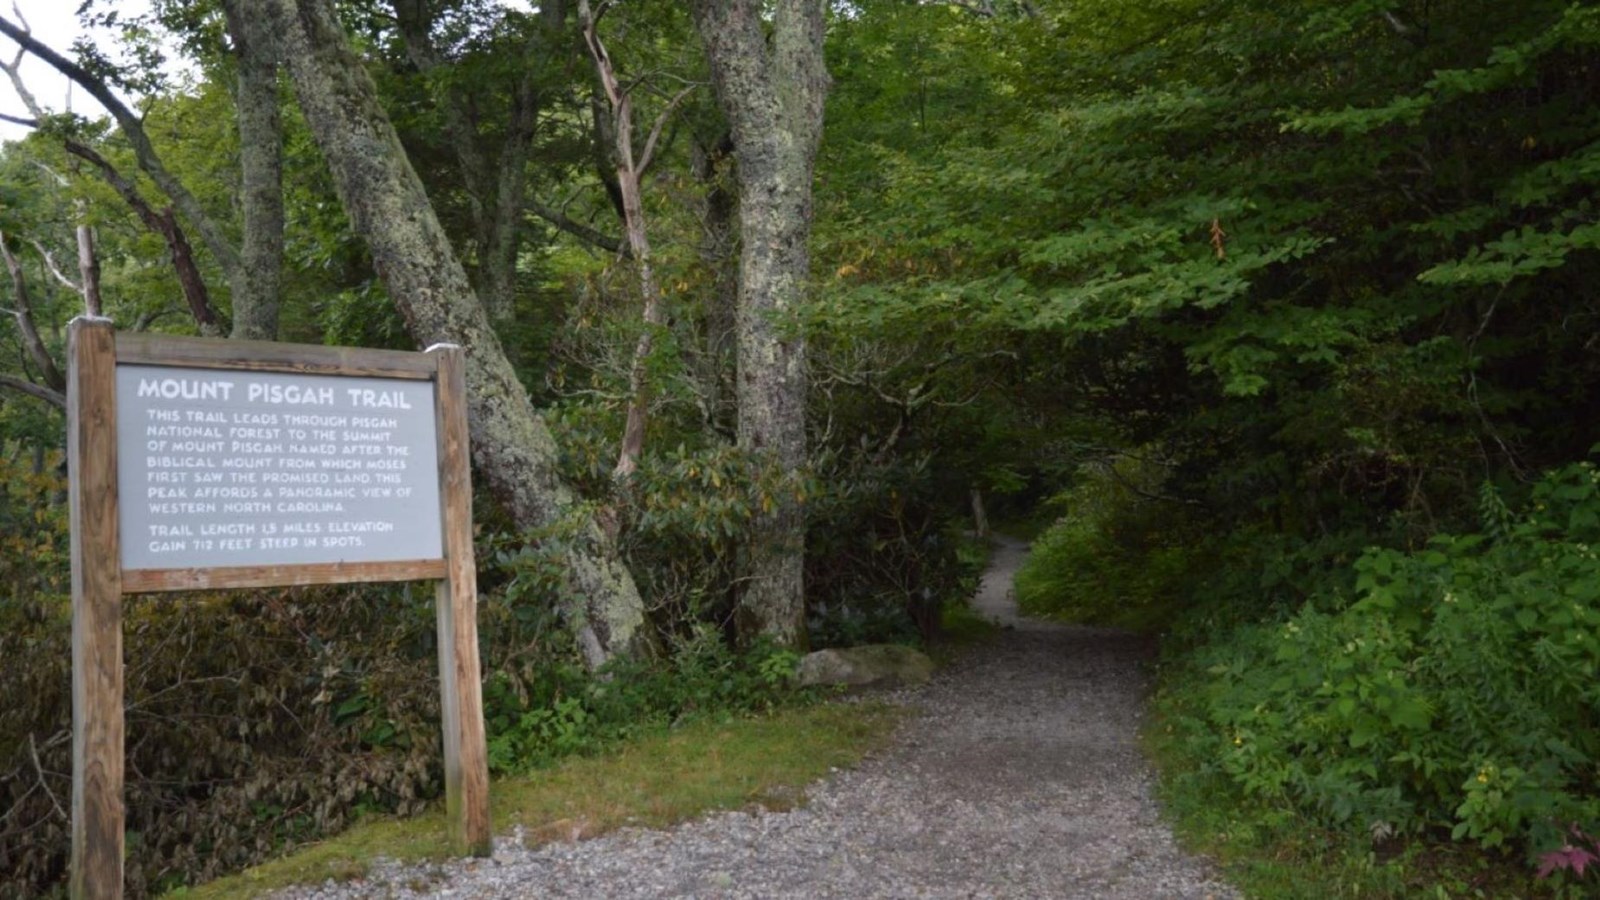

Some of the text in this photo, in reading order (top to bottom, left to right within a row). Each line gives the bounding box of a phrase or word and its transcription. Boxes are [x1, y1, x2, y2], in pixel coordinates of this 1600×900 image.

[137, 378, 412, 409] MOUNT PISGAH TRAIL
[147, 409, 397, 428] THIS TRAIL LEADS THROUGH PISGAH
[147, 426, 391, 442] NATIONAL FOREST TO THE SUMMIT
[147, 440, 409, 456] OF MOUNT PISGAH NAMED AFTER THE
[147, 456, 407, 470] BIBLICAL MOUNT FROM WHICH MOSES
[147, 472, 187, 483] FIRST
[194, 472, 223, 483] SAW
[229, 473, 257, 483] THE
[262, 473, 329, 483] PROMISED
[375, 473, 401, 483] THIS
[147, 487, 412, 498] PEAK AFFORDS A PANORAMIC VIEW OF
[149, 503, 216, 514] WESTERN
[223, 502, 271, 512] NORTH
[149, 525, 194, 536] TRAIL
[200, 524, 255, 535] LENGTH
[328, 522, 394, 532] ELEVATION
[149, 540, 185, 552] GAIN
[193, 540, 213, 550] 712
[220, 538, 253, 550] FEET
[260, 537, 298, 549] STEEP
[304, 538, 317, 547] IN
